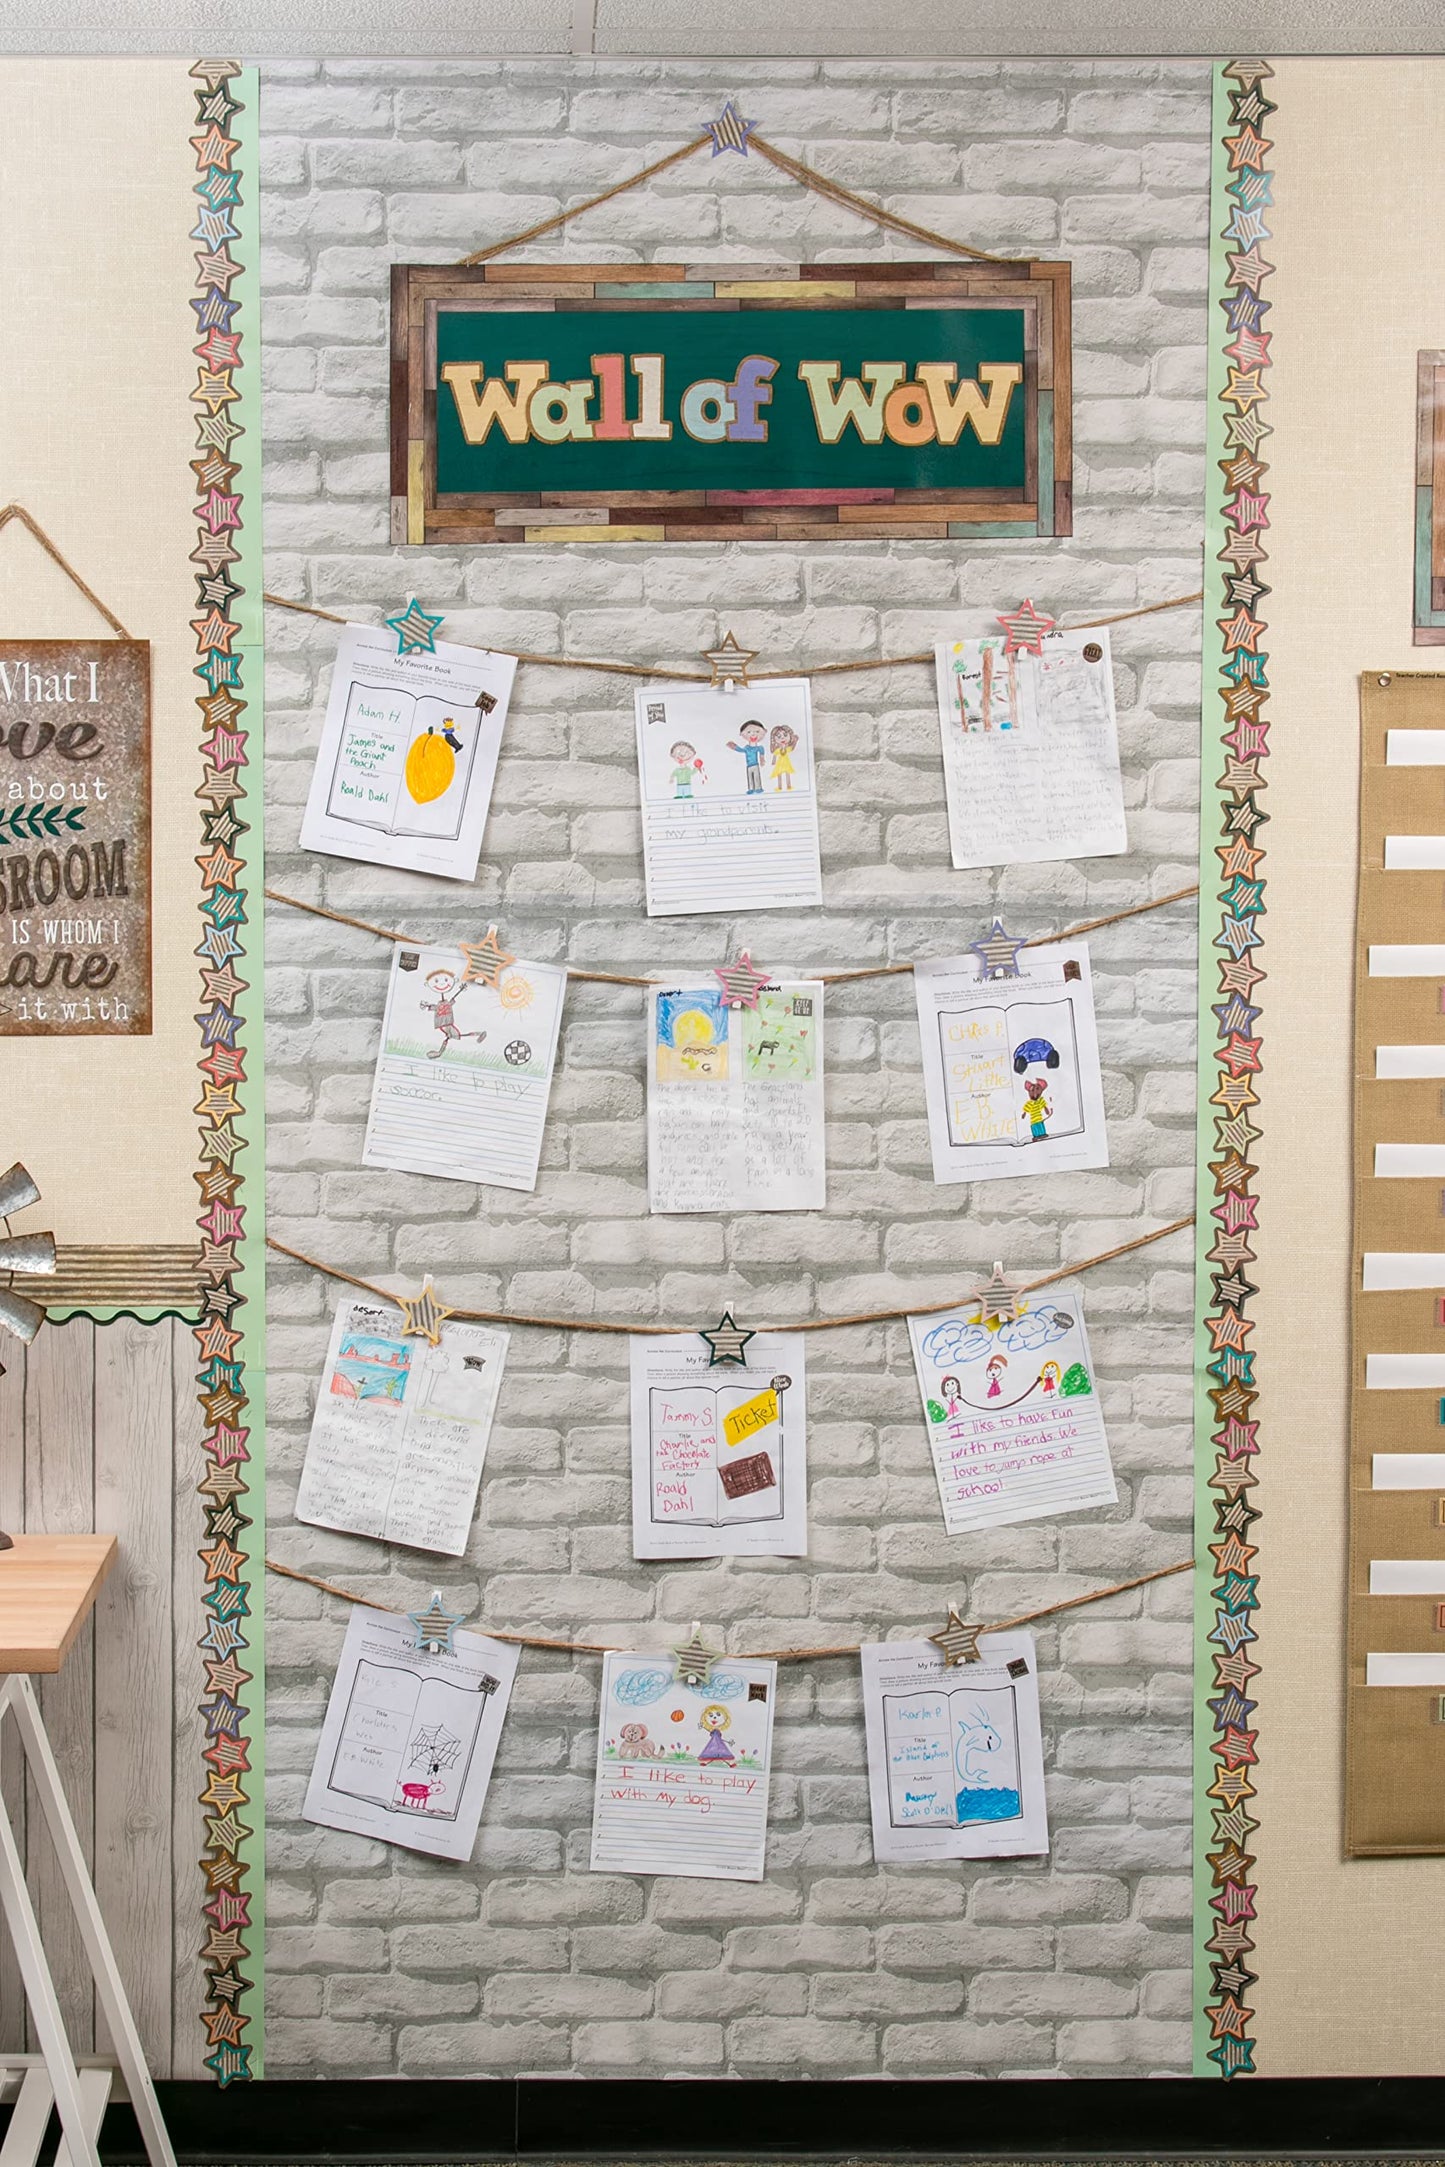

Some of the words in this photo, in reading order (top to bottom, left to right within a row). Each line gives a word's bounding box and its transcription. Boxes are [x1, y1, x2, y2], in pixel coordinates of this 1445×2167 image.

[441, 353, 672, 444] Wall
[681, 354, 780, 444] of
[393, 658, 404, 667] My
[405, 658, 433, 671] Favorite
[434, 666, 451, 675] Book
[87, 661, 100, 703] I
[358, 703, 385, 720] Adam
[360, 749, 387, 761] Giant
[380, 743, 395, 752] and
[360, 771, 380, 779] Author
[8, 776, 108, 800] about
[341, 780, 364, 798] Roald
[368, 788, 389, 804] Dahl
[12, 919, 30, 944] IS
[43, 919, 103, 945] WHOM
[113, 919, 120, 944] I
[18, 997, 47, 1020] it
[61, 997, 128, 1021] with
[402, 1064, 419, 1077] I
[432, 1066, 458, 1083] like
[494, 1075, 533, 1101] play
[686, 1357, 696, 1365] My
[661, 1403, 699, 1426] Tammy
[948, 1422, 965, 1439] I
[1000, 1415, 1014, 1428] to
[660, 1438, 699, 1450] Charlie
[700, 1437, 716, 1445] and
[951, 1442, 987, 1460] with
[992, 1440, 1012, 1454] my
[1058, 1423, 1079, 1440] We
[662, 1460, 700, 1471] Factory
[953, 1466, 981, 1480] love
[983, 1463, 997, 1473] to
[1030, 1452, 1058, 1465] rope
[1061, 1446, 1075, 1458] at
[656, 1481, 687, 1497] Roald
[663, 1496, 694, 1513] Dahl
[401, 1639, 413, 1649] My
[442, 1650, 458, 1659] Book
[917, 1662, 928, 1670] My
[376, 1709, 388, 1717] Title
[363, 1746, 383, 1755] Author
[618, 1766, 634, 1779] I
[650, 1768, 686, 1784] like
[699, 1774, 713, 1785] to
[723, 1775, 757, 1794] play
